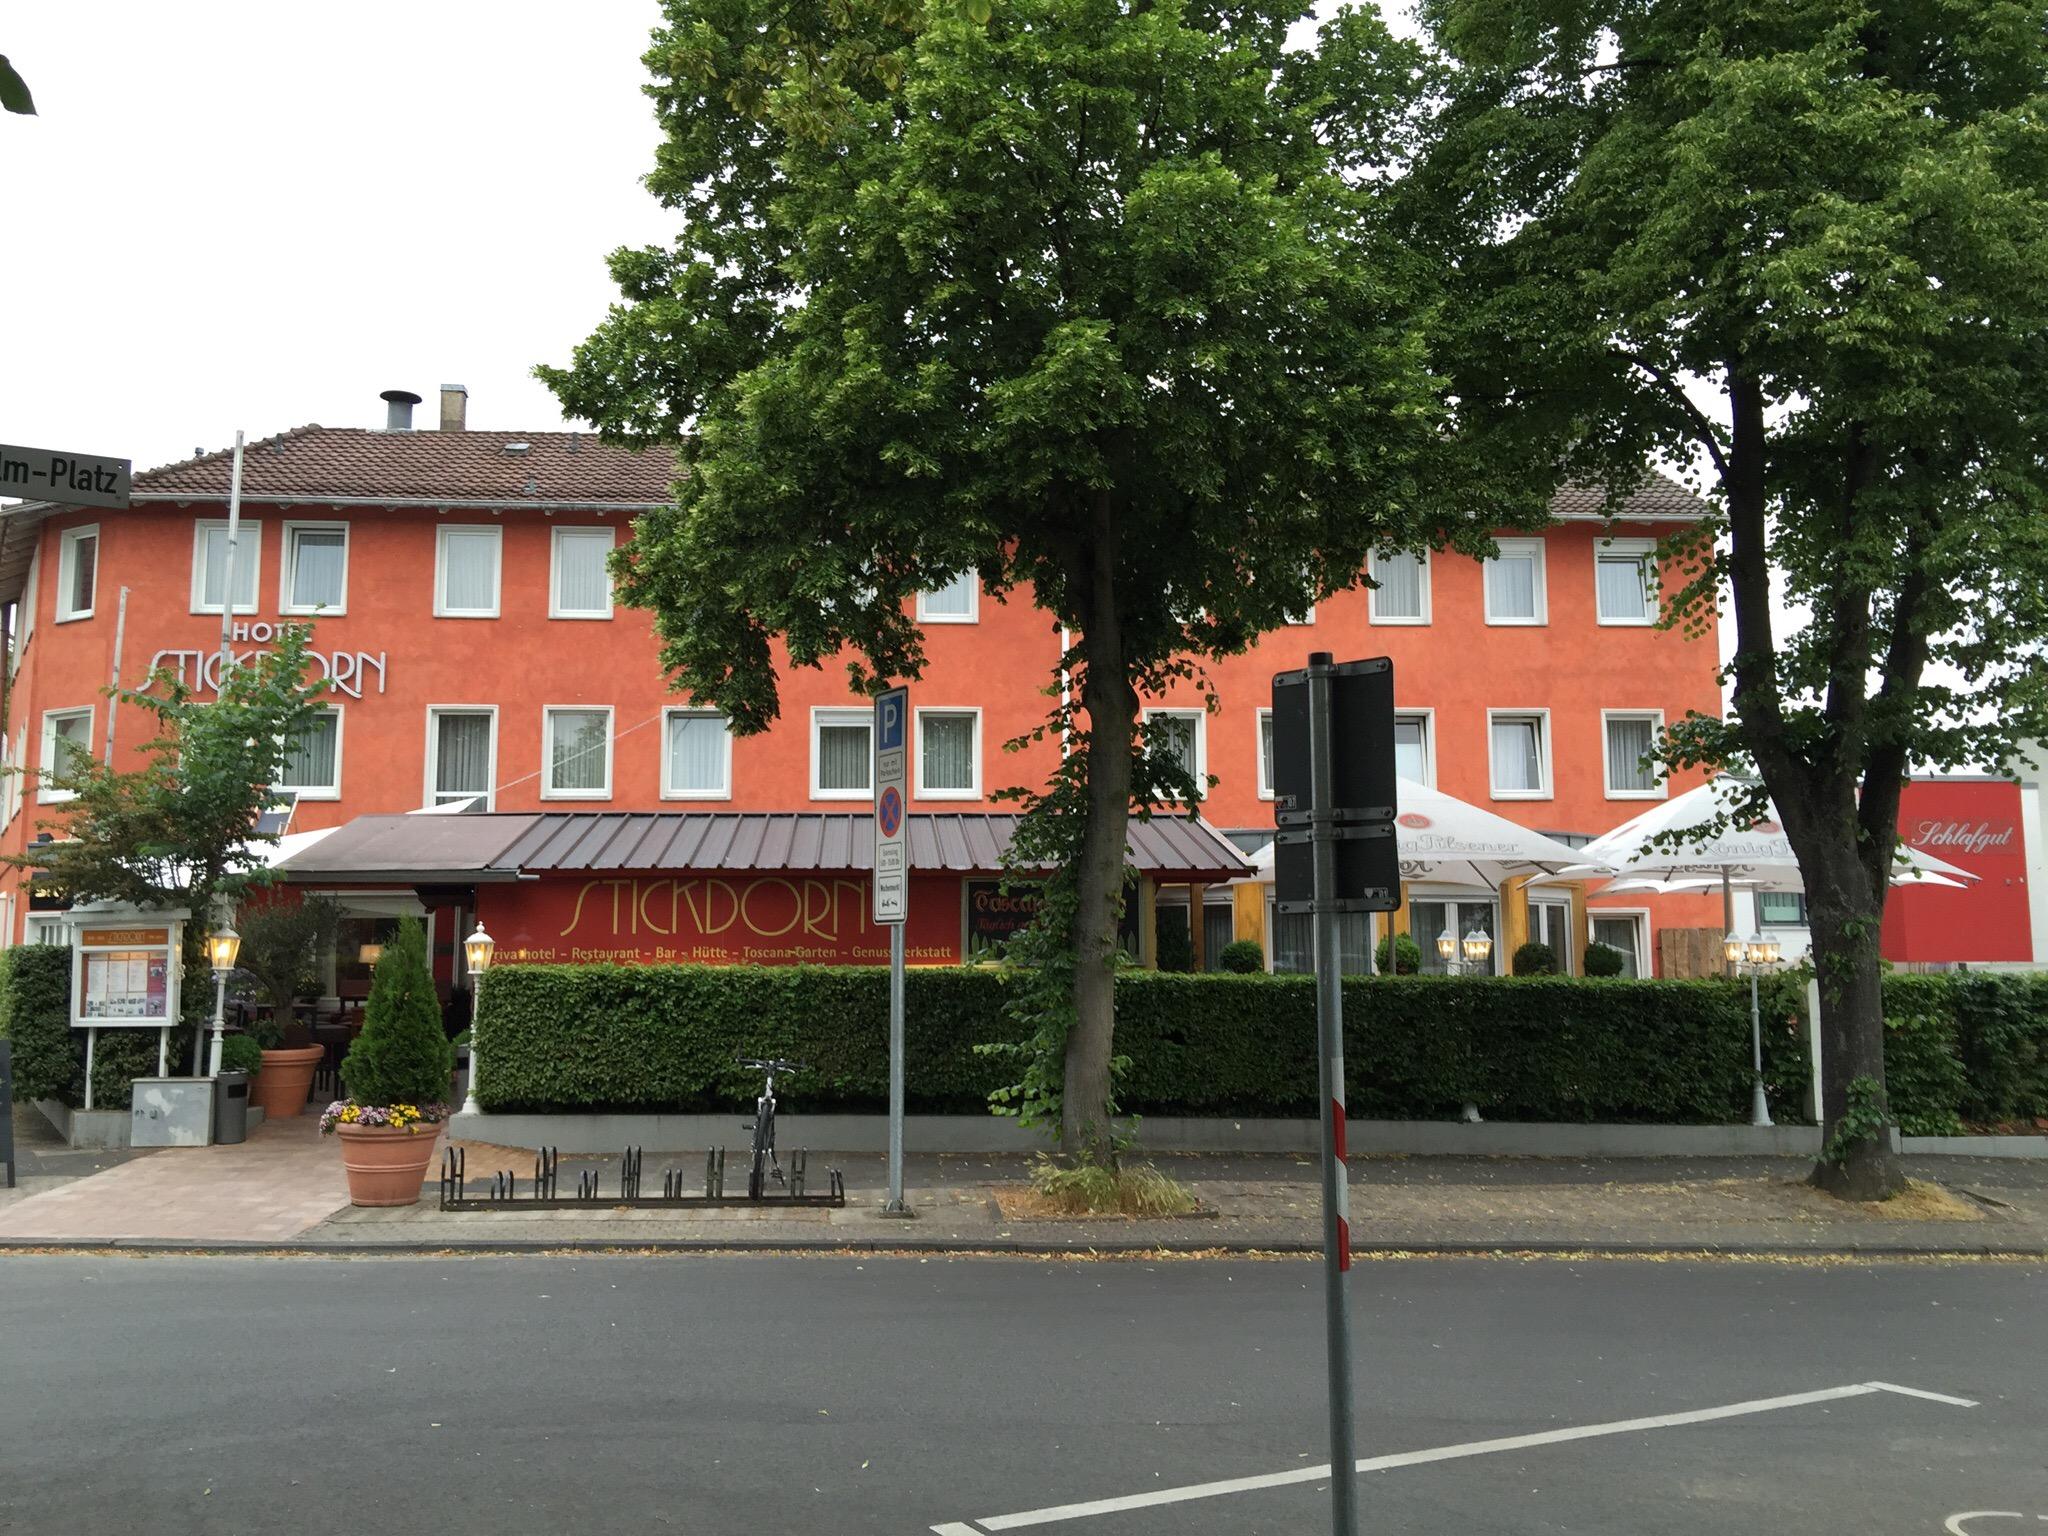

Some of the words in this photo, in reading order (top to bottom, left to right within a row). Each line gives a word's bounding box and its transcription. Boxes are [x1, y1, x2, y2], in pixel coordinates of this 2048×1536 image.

[136, 649, 387, 698] STICKORN
[883, 703, 897, 743] P
[1912, 820, 2014, 853] Schlafgut
[560, 877, 865, 942] STICKDORN
[492, 947, 556, 960] rivahotel
[572, 947, 640, 960] Restaurant
[655, 946, 677, 959] Bar
[692, 945, 728, 958] Hütte
[743, 945, 837, 959] Toscana-Garten
[852, 945, 952, 958] Genusserkstatt
